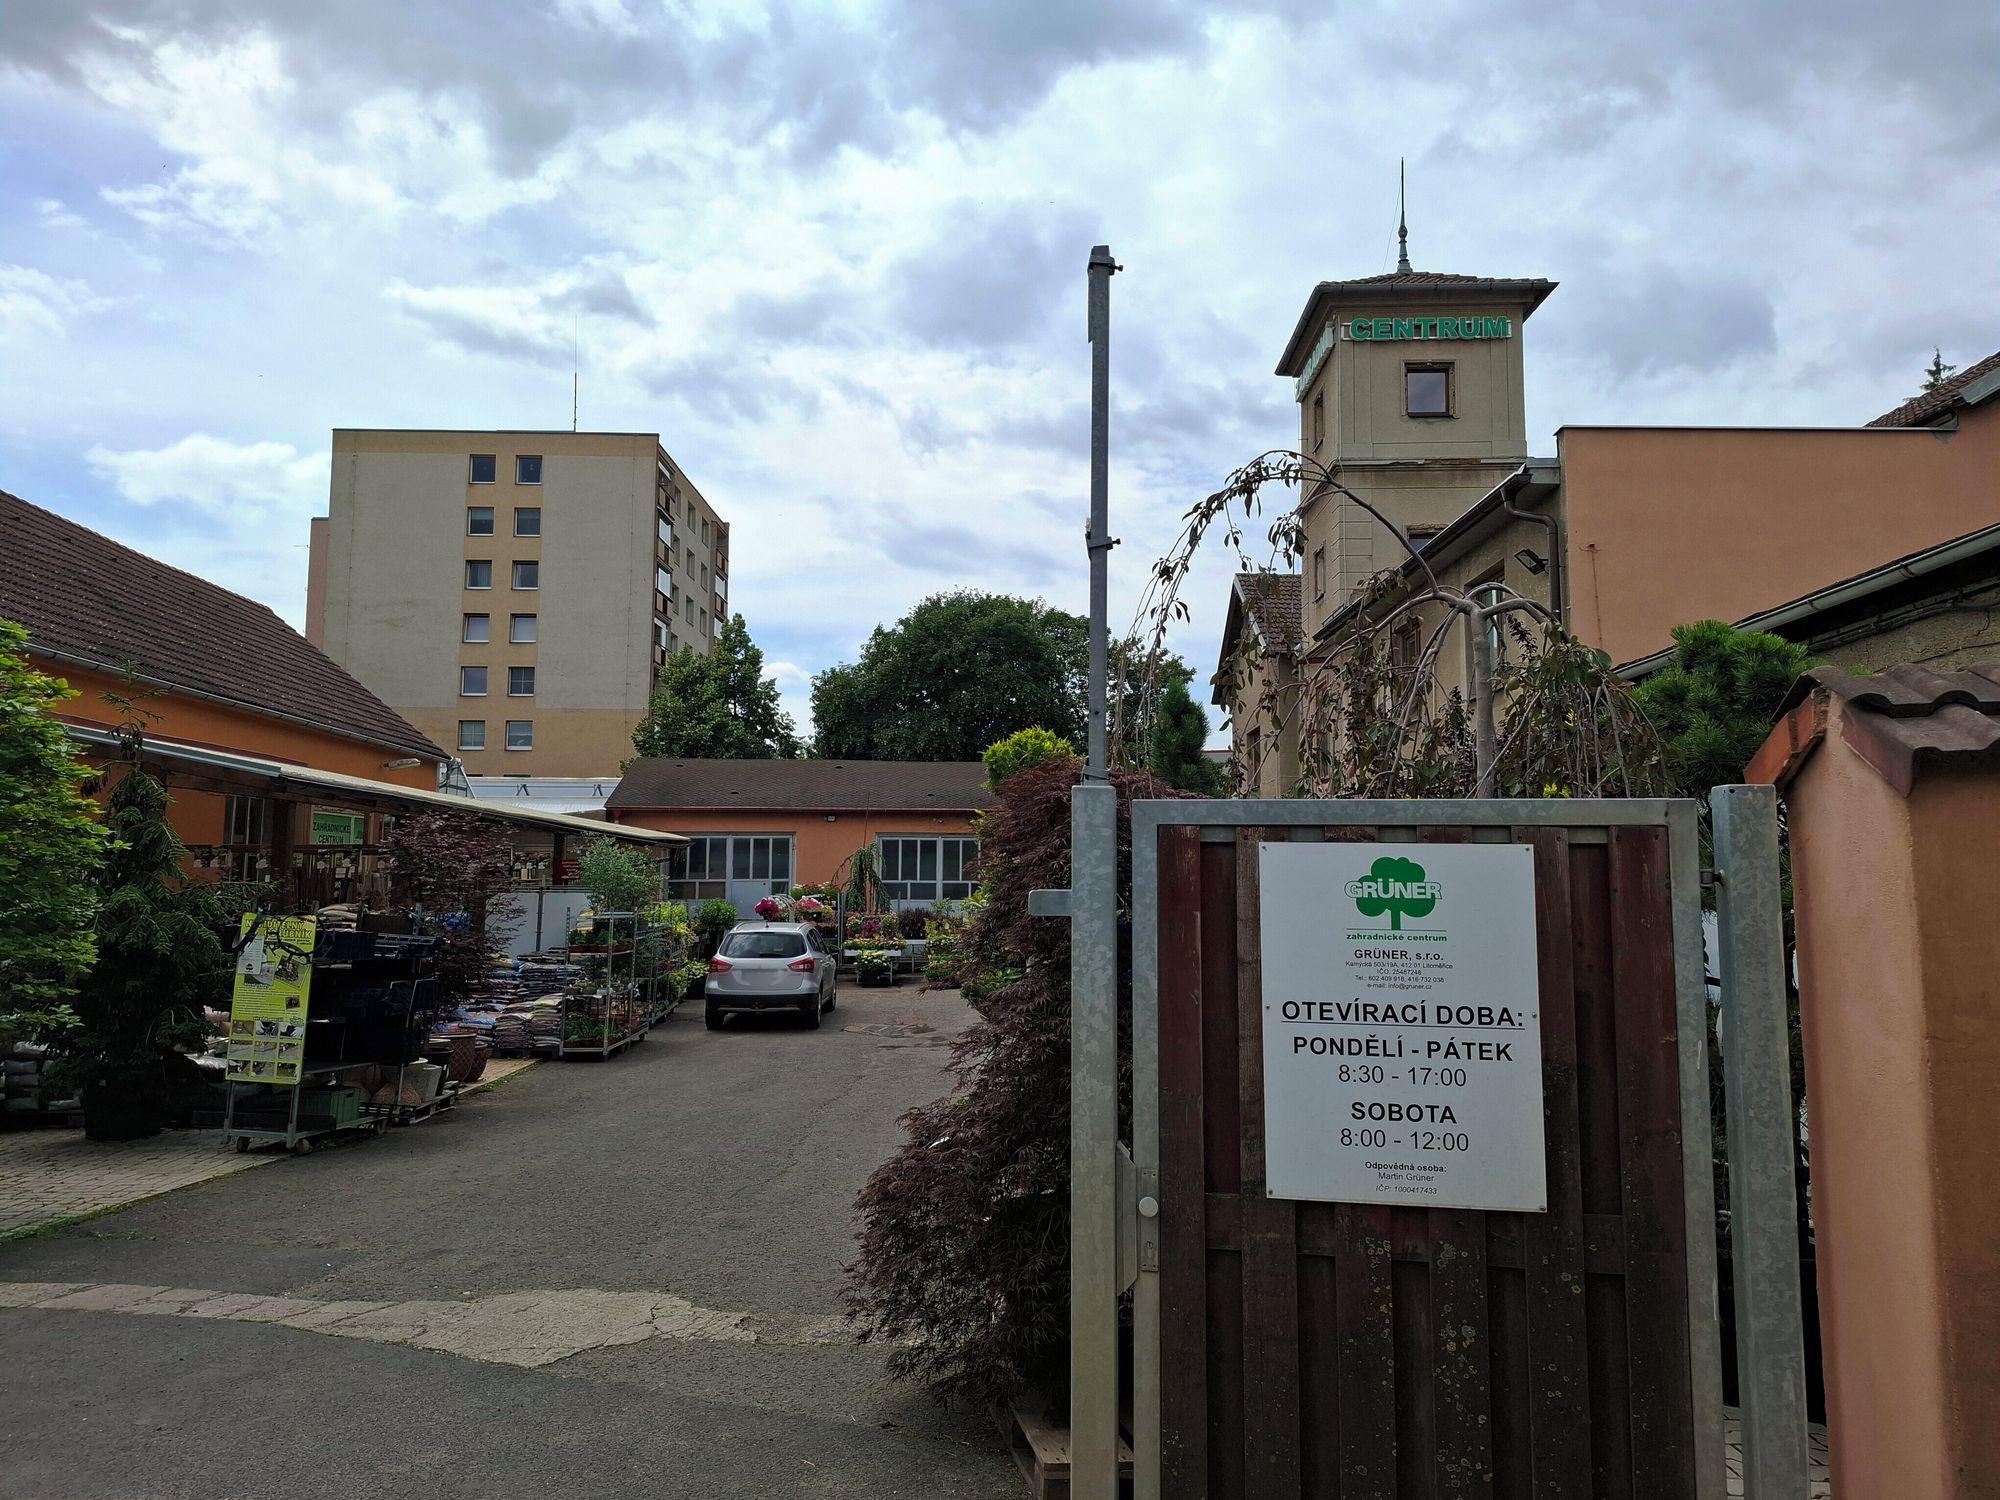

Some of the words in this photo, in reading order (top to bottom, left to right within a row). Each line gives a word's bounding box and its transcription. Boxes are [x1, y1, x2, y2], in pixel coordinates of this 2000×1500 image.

[1349, 315, 1508, 341] CENTRUM
[313, 822, 351, 833] ZAHRADNICKÉ
[319, 835, 344, 844] CENTRUM
[1344, 878, 1442, 900] GRÜNER
[1346, 933, 1404, 941] zahradnické
[1407, 934, 1448, 942] centrum
[1354, 947, 1412, 961] GRÜNER,
[1415, 952, 1444, 961] s.r.o.
[1387, 983, 1432, 991] info@gruner.cz
[1281, 999, 1427, 1025] OTEVÍRACÍ
[1436, 1005, 1524, 1027] DOBA:
[1294, 1034, 1403, 1058] PONDĚLÍ
[1427, 1037, 1513, 1061] PÁTEK
[1338, 1064, 1384, 1083] 8:30
[1408, 1067, 1466, 1086] 17:00
[1351, 1102, 1457, 1124] SOBOTA
[1340, 1128, 1386, 1147] 8:00
[1410, 1131, 1469, 1151] 12:00
[1365, 1161, 1414, 1171] Odpovědná
[1417, 1163, 1447, 1172] osoba:
[1378, 1172, 1403, 1180] Martin
[1406, 1173, 1434, 1182] Grüner
[1375, 1184, 1391, 1192] IČP:
